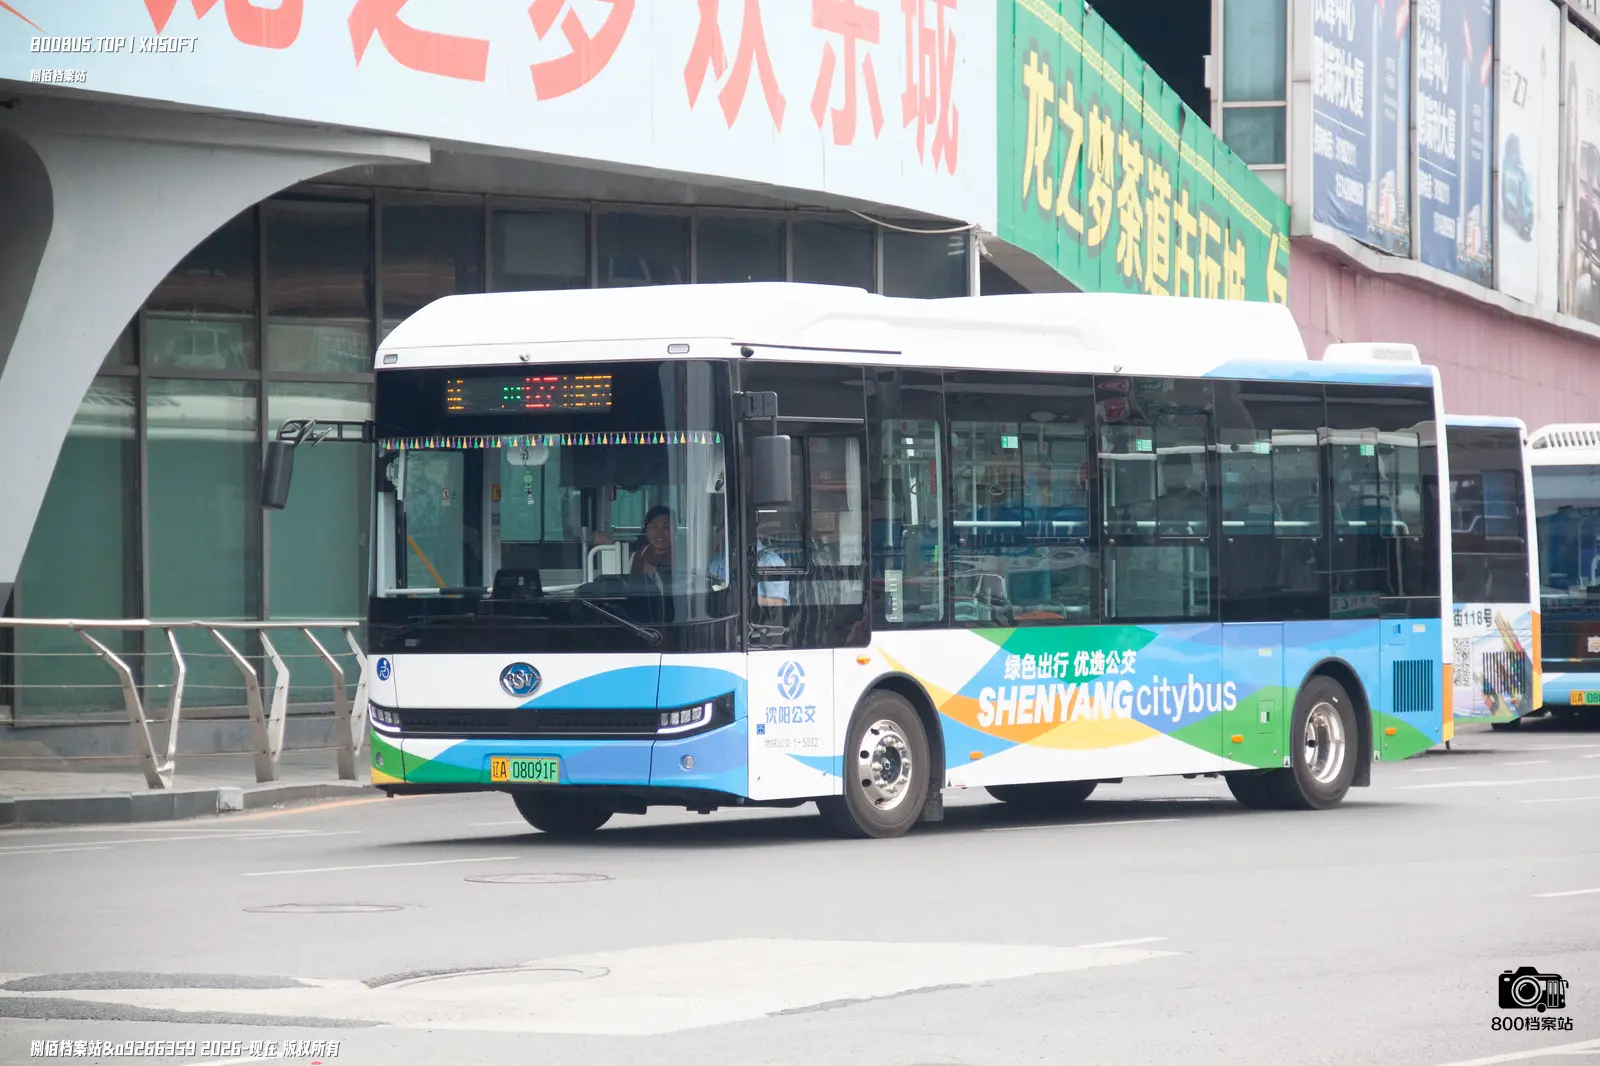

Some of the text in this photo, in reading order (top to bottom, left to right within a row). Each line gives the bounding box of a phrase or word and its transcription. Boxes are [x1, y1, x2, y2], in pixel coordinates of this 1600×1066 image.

[1003, 649, 1137, 681] 绿色出行 优选公交
[977, 673, 1237, 728] SHENYANG citybus
[765, 705, 816, 724] 沈阳公交
[512, 761, 557, 779] 08091F
